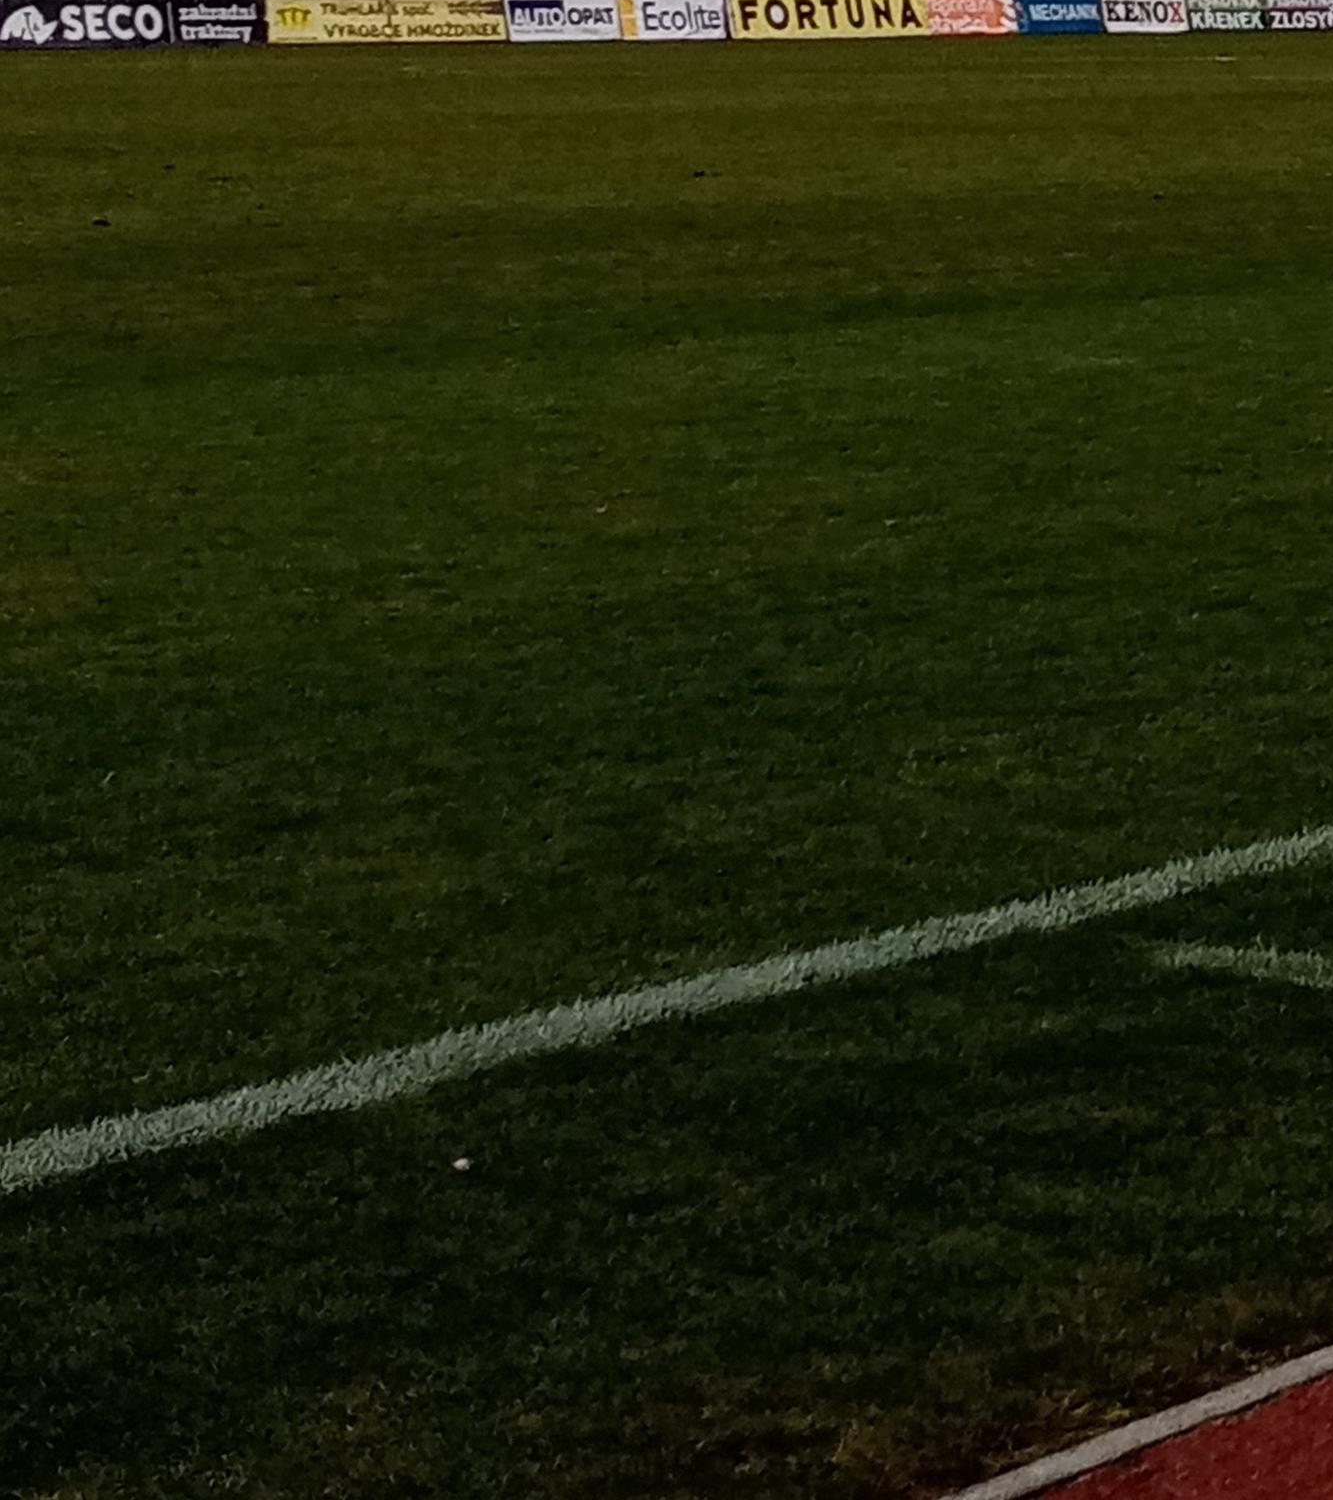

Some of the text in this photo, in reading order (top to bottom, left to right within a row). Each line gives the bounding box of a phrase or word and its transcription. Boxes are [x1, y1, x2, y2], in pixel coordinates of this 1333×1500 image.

[60, 4, 164, 41] SECO
[641, 1, 721, 33] Ecolite
[1104, 0, 1185, 24] KENOX
